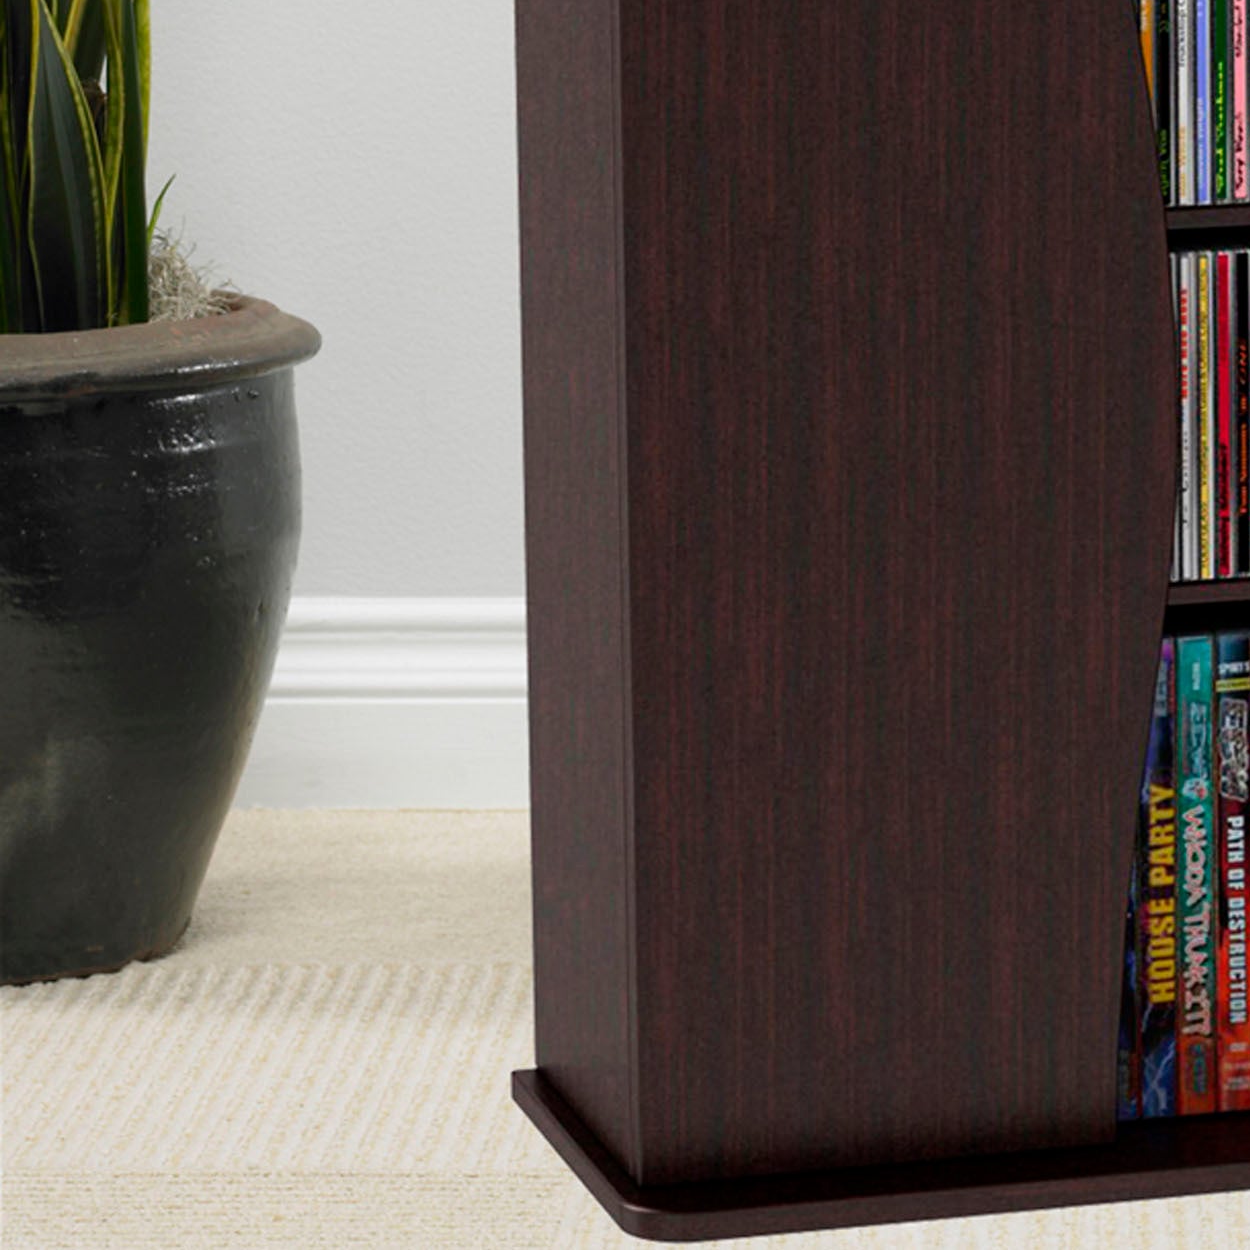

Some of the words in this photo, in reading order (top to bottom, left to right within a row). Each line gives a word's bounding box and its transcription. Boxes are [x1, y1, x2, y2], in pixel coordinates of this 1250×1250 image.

[1149, 784, 1174, 886] PARTY
[1183, 805, 1206, 905] WHODA
[1227, 816, 1244, 860] PATH
[1228, 868, 1244, 890] OF
[1149, 900, 1174, 1004] HOUSE
[1184, 902, 1210, 990] THUNK
[1229, 897, 1246, 1023] DESTRUCTION
